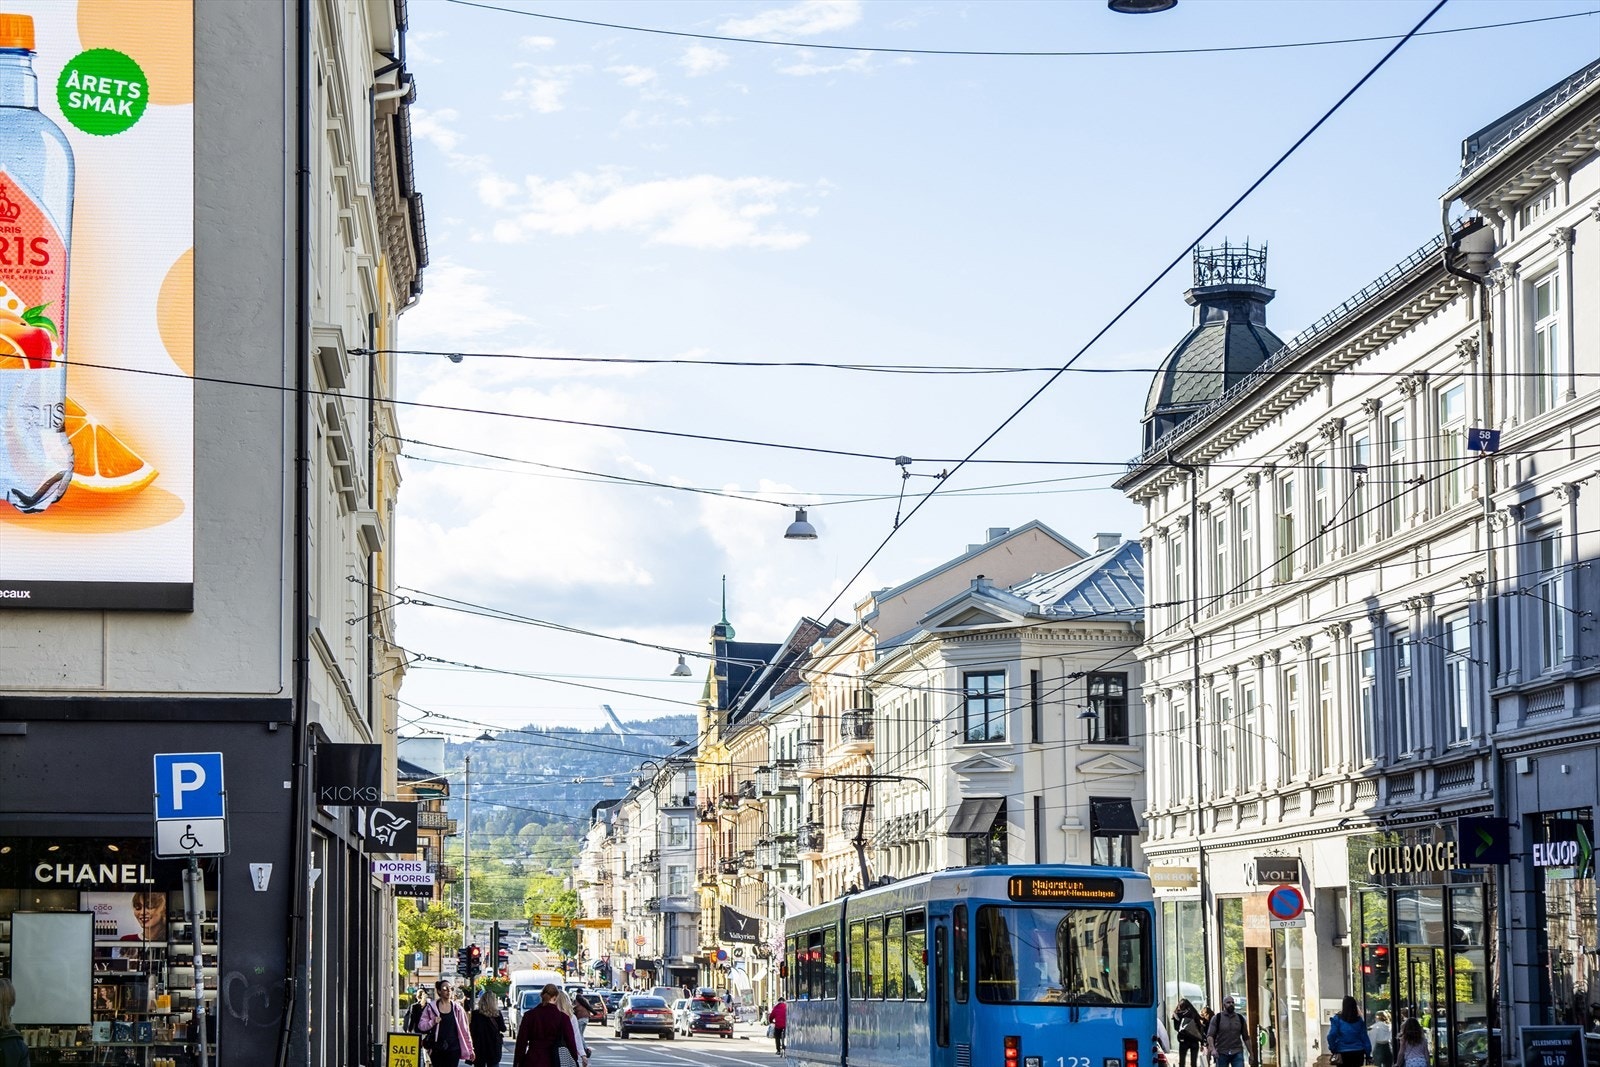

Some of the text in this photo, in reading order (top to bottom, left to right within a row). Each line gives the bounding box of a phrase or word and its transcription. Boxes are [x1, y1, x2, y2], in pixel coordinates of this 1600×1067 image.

[65, 69, 141, 99] ÅRETS
[68, 91, 134, 117] SMAK
[1479, 430, 1491, 440] 58
[1480, 440, 1488, 450] V
[172, 762, 206, 811] P
[321, 786, 378, 802] KICKS
[379, 863, 422, 872] MORRIS
[34, 863, 155, 884] CHANEL
[393, 874, 431, 883] MORRIS
[1260, 870, 1298, 881] VOLT
[729, 931, 756, 941] Valkyrien
[392, 1045, 416, 1055] SALE
[394, 1058, 413, 1067] 70%
[1056, 1056, 1091, 1067] 123
[1543, 1055, 1565, 1066] 10-19
